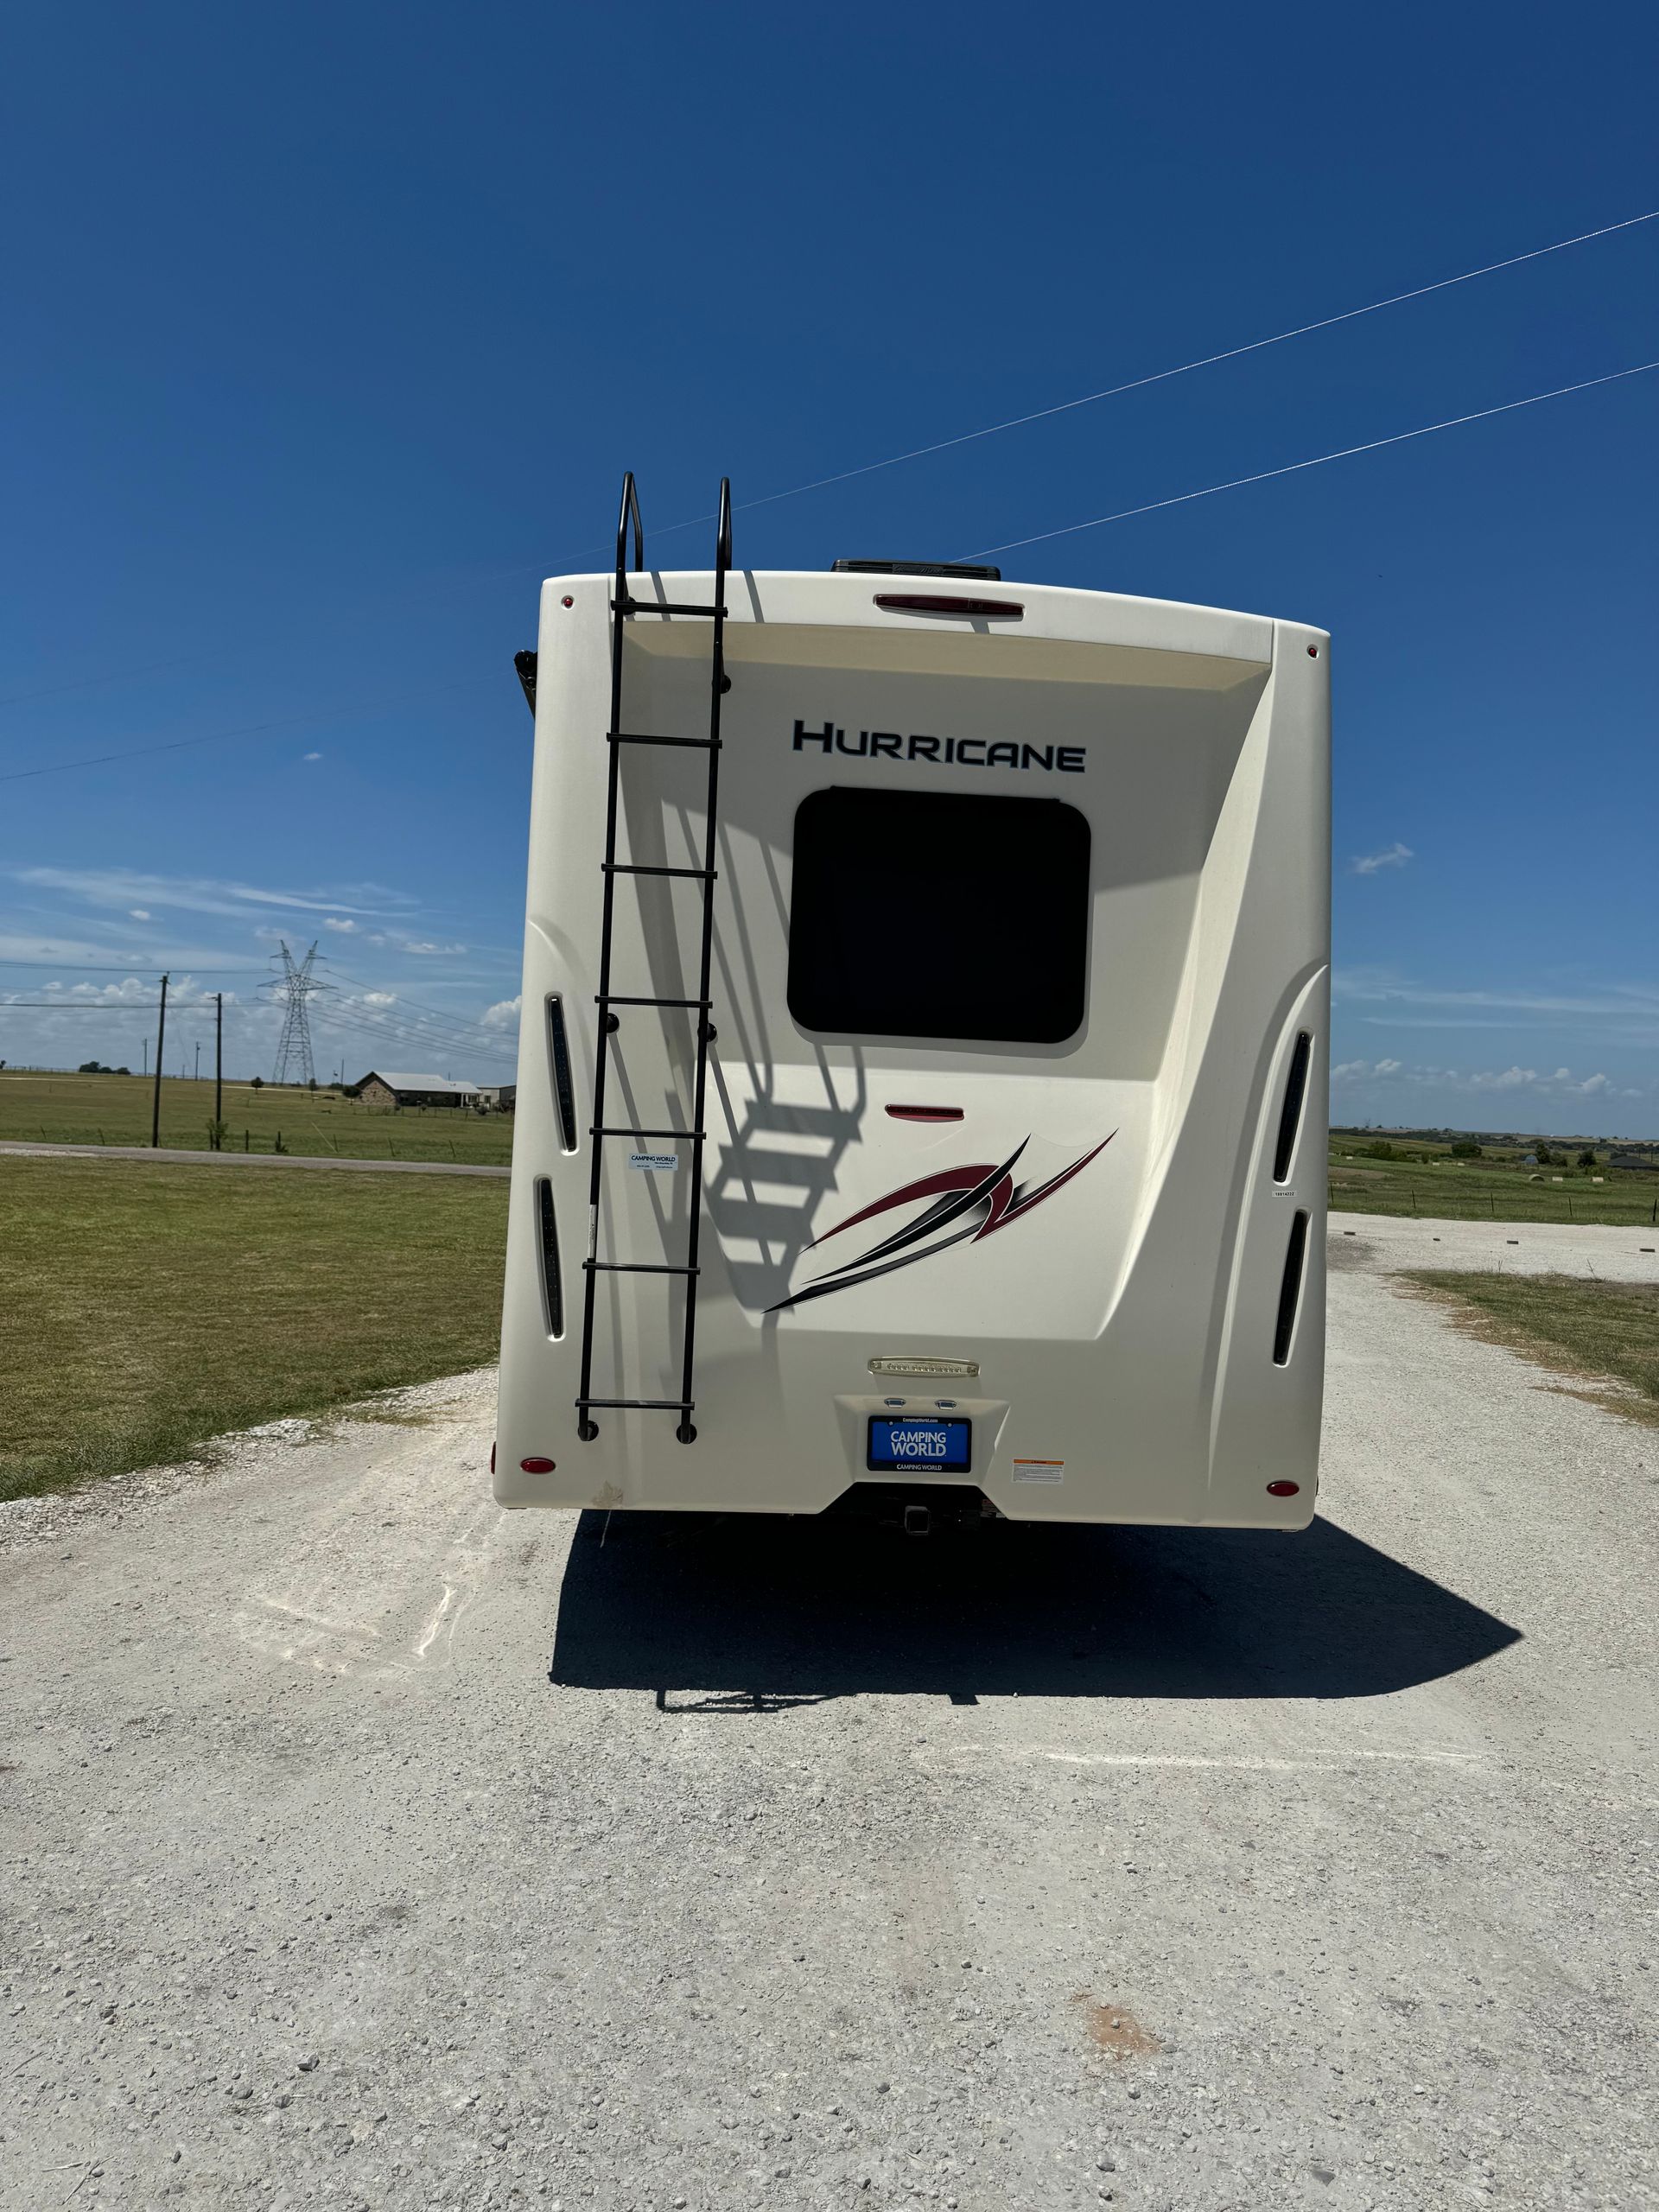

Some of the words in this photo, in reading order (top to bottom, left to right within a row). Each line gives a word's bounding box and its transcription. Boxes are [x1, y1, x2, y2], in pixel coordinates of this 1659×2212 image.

[792, 719, 1086, 773] HURRICANE
[890, 1431, 946, 1443] CAMPING
[891, 1442, 946, 1457] WORLD
